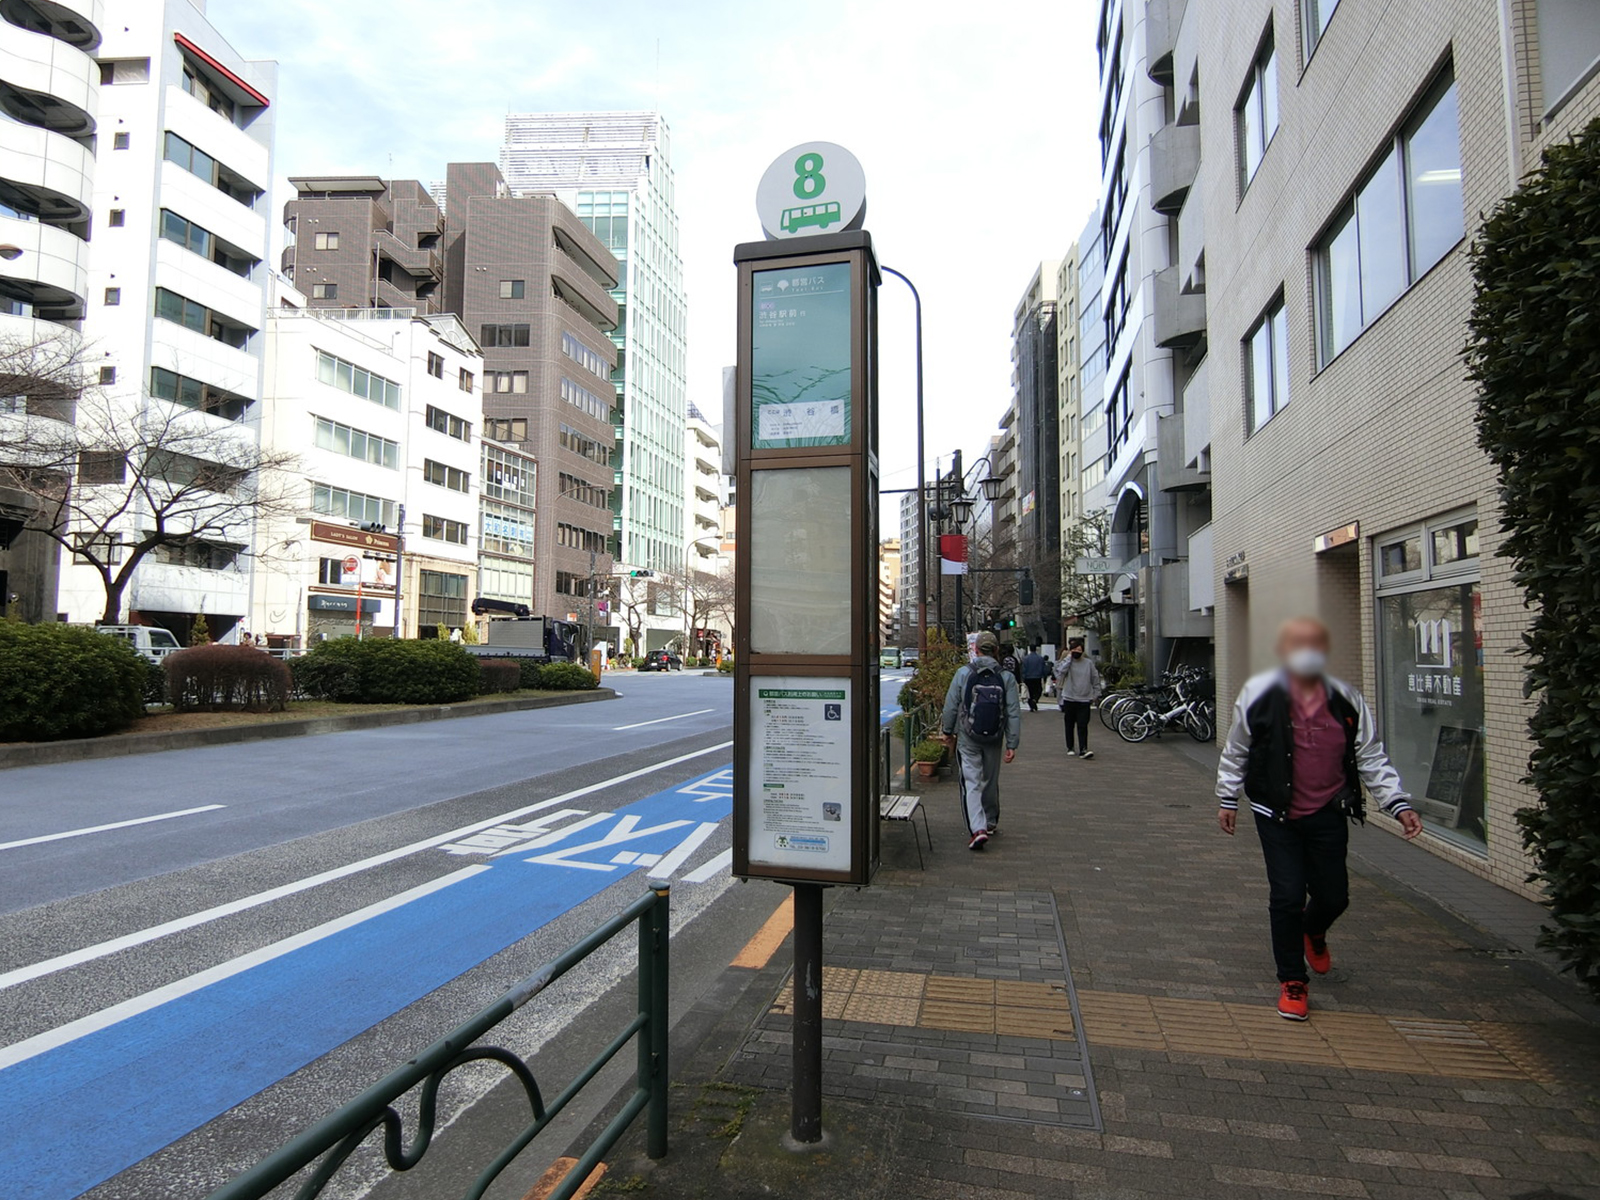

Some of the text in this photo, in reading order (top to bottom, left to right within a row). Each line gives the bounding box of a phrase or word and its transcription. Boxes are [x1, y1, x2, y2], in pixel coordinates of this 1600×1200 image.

[793, 152, 826, 200] 8
[758, 309, 797, 320] 渋谷駅前
[1408, 674, 1461, 696] 恵比寿不動産
[438, 808, 734, 883] バス停
